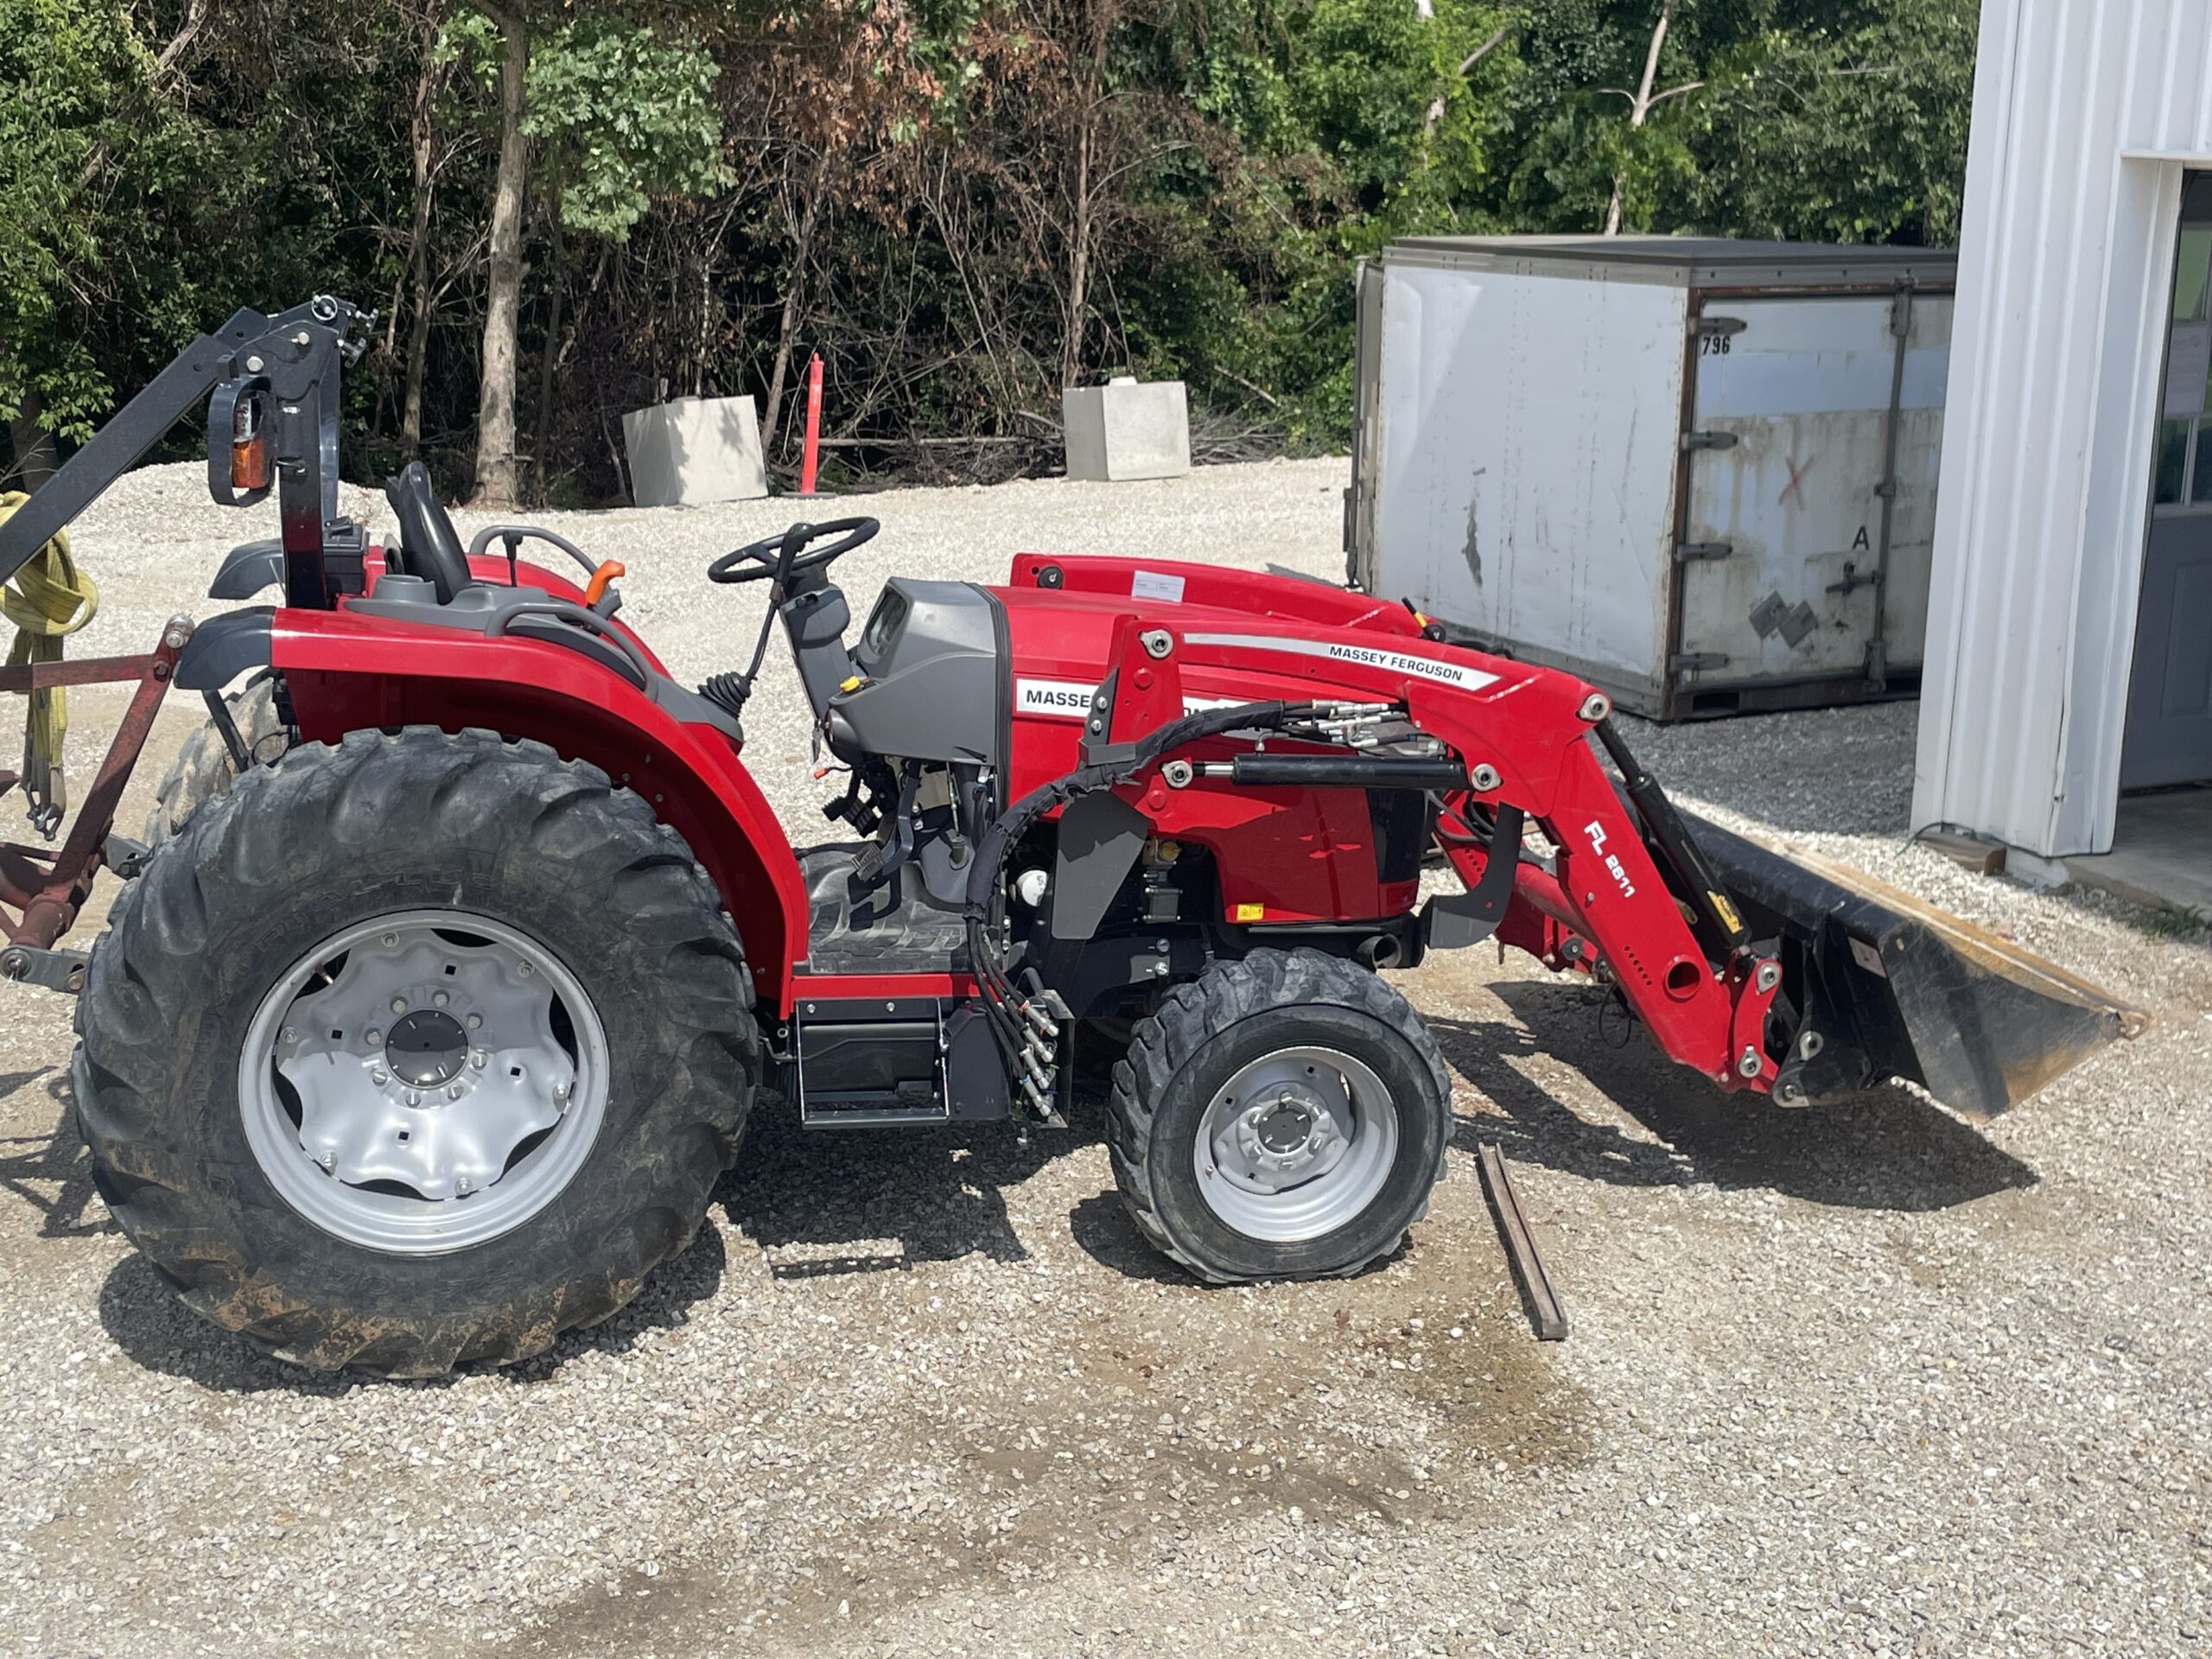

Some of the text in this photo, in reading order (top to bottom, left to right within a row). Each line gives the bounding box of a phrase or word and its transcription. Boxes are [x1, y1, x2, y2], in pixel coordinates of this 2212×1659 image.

[1702, 335, 1731, 356] 796
[1852, 525, 1870, 550] A
[1329, 645, 1463, 681] MASSEY FERGUSON
[1584, 820, 1636, 899] FL 2611
